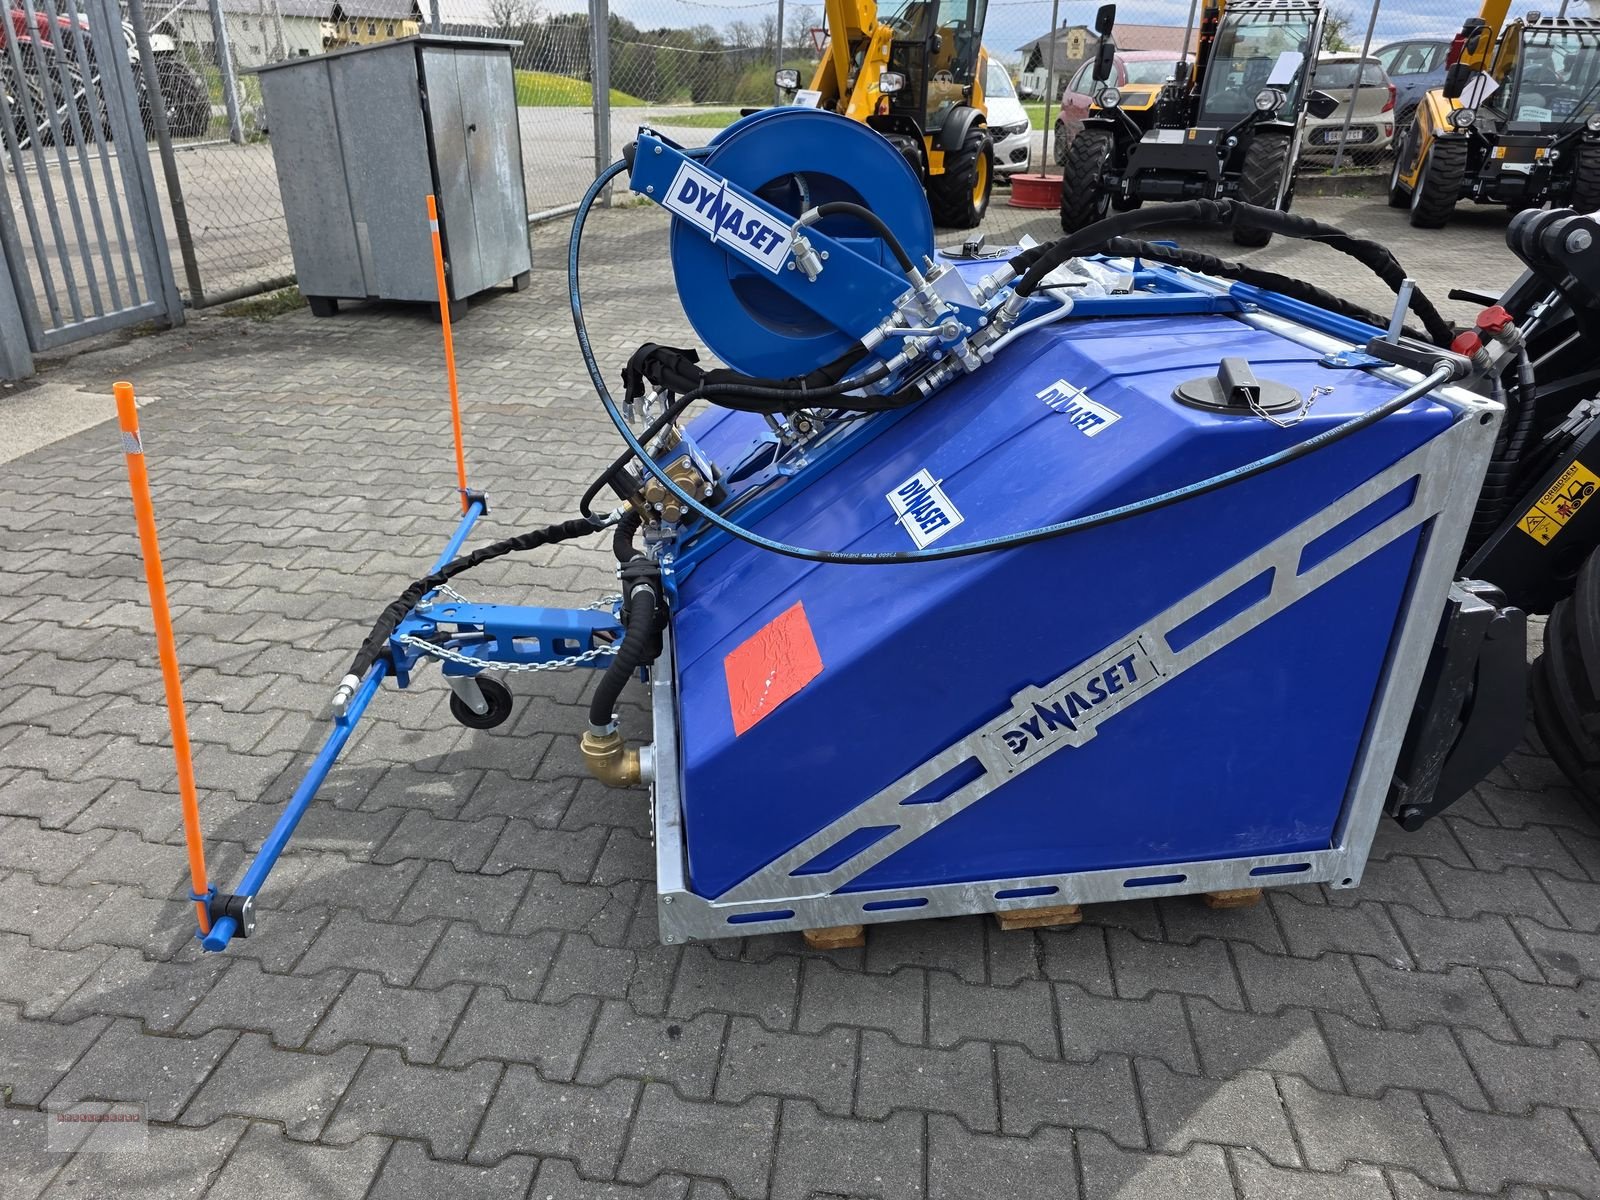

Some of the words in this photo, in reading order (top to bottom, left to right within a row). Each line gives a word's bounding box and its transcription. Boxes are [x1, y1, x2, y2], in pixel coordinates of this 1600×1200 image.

[677, 177, 786, 256] DYNASET
[1041, 388, 1107, 432] DYNASET
[897, 478, 951, 535] DYNASET
[1540, 465, 1577, 504] FORBIDDEN
[1001, 653, 1138, 755] DYNASET
